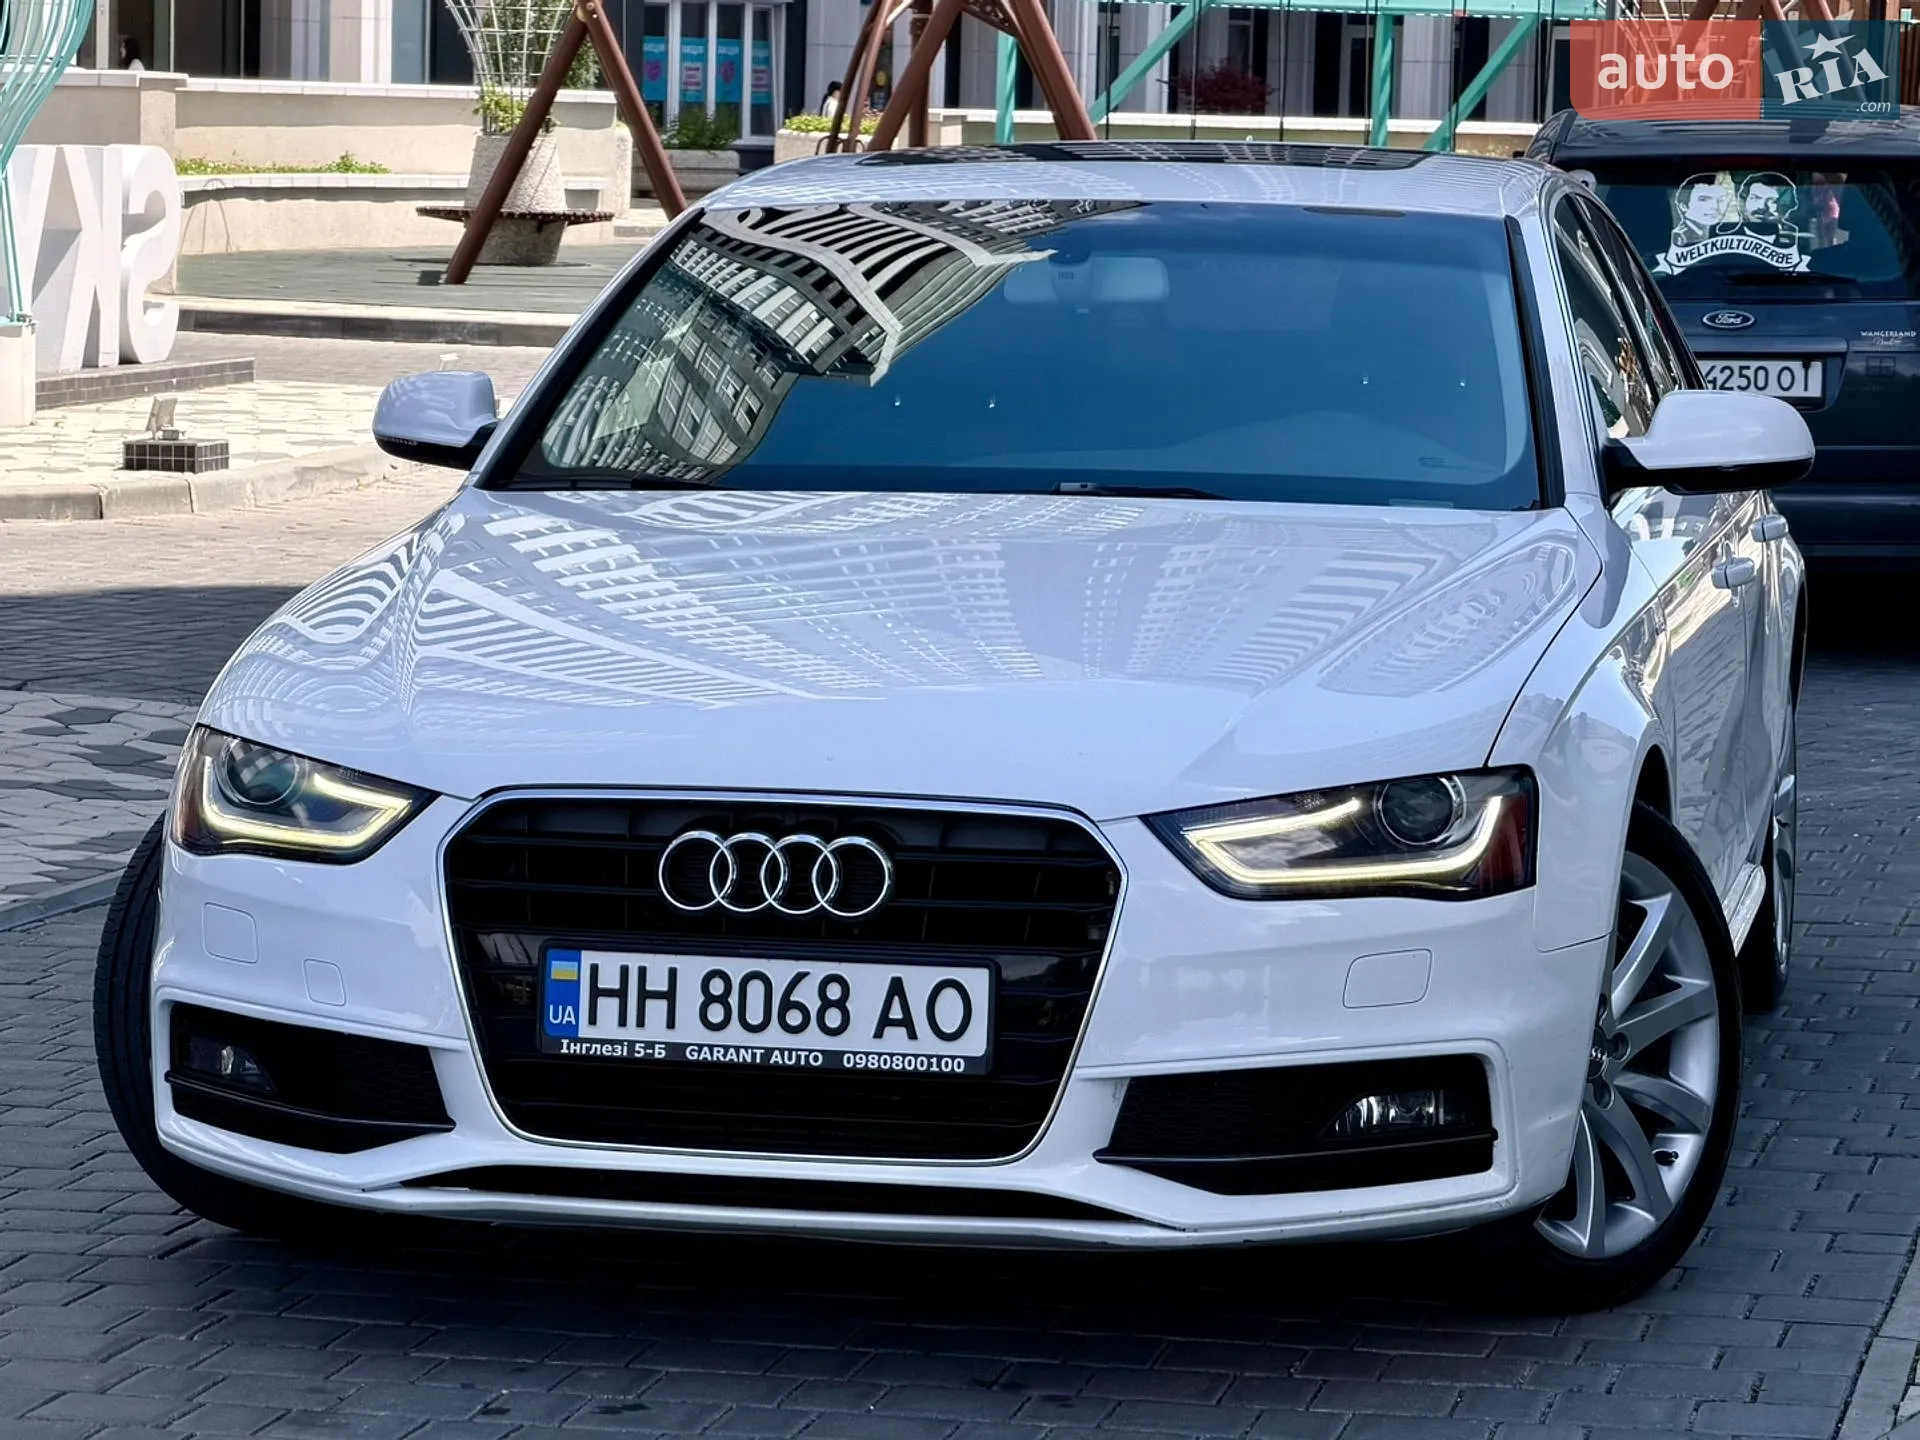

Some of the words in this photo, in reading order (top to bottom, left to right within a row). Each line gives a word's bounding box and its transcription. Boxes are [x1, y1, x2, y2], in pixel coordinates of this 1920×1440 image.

[1675, 238, 1793, 264] WELTKULTURERBE
[587, 962, 679, 1030] HH
[698, 968, 852, 1037] 8068
[872, 975, 973, 1042] AO
[549, 1004, 577, 1026] UA
[560, 1038, 628, 1057] Інглезі
[634, 1042, 667, 1059] 5-Б
[685, 1045, 764, 1064] GARANT
[769, 1050, 823, 1067] AUTO
[842, 1053, 966, 1073] 0980800100
